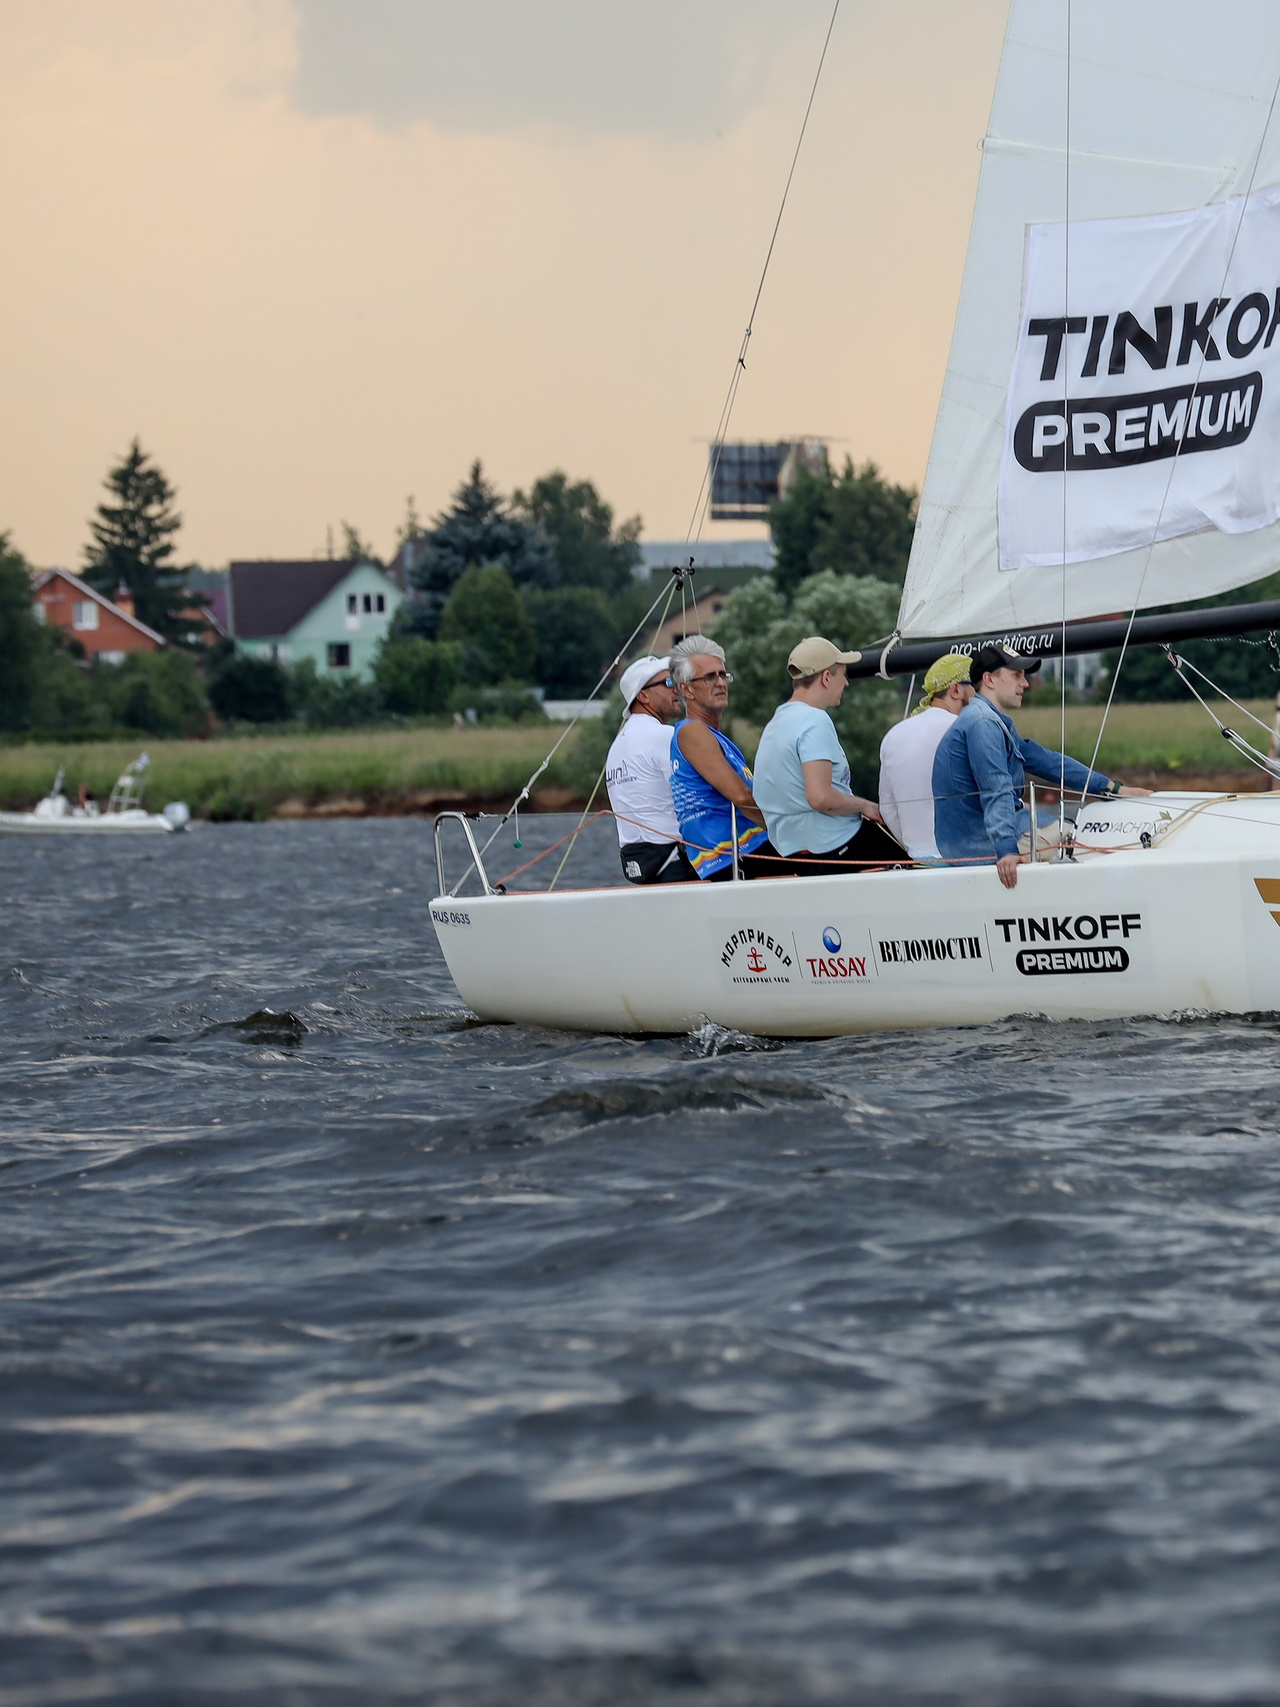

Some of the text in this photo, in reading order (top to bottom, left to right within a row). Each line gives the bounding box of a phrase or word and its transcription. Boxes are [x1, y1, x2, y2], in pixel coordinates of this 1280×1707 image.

[1032, 384, 1256, 458] PREMIUM
[1081, 822, 1169, 835] PROYACHTING
[432, 910, 471, 925] RUS 0635
[994, 913, 1142, 943] TINKOFF
[721, 928, 793, 968] МОРПРИБОР
[878, 937, 983, 965] ВЕДОМОСТИ
[806, 956, 867, 978] TASSAY
[1022, 950, 1123, 972] PREMIUM
